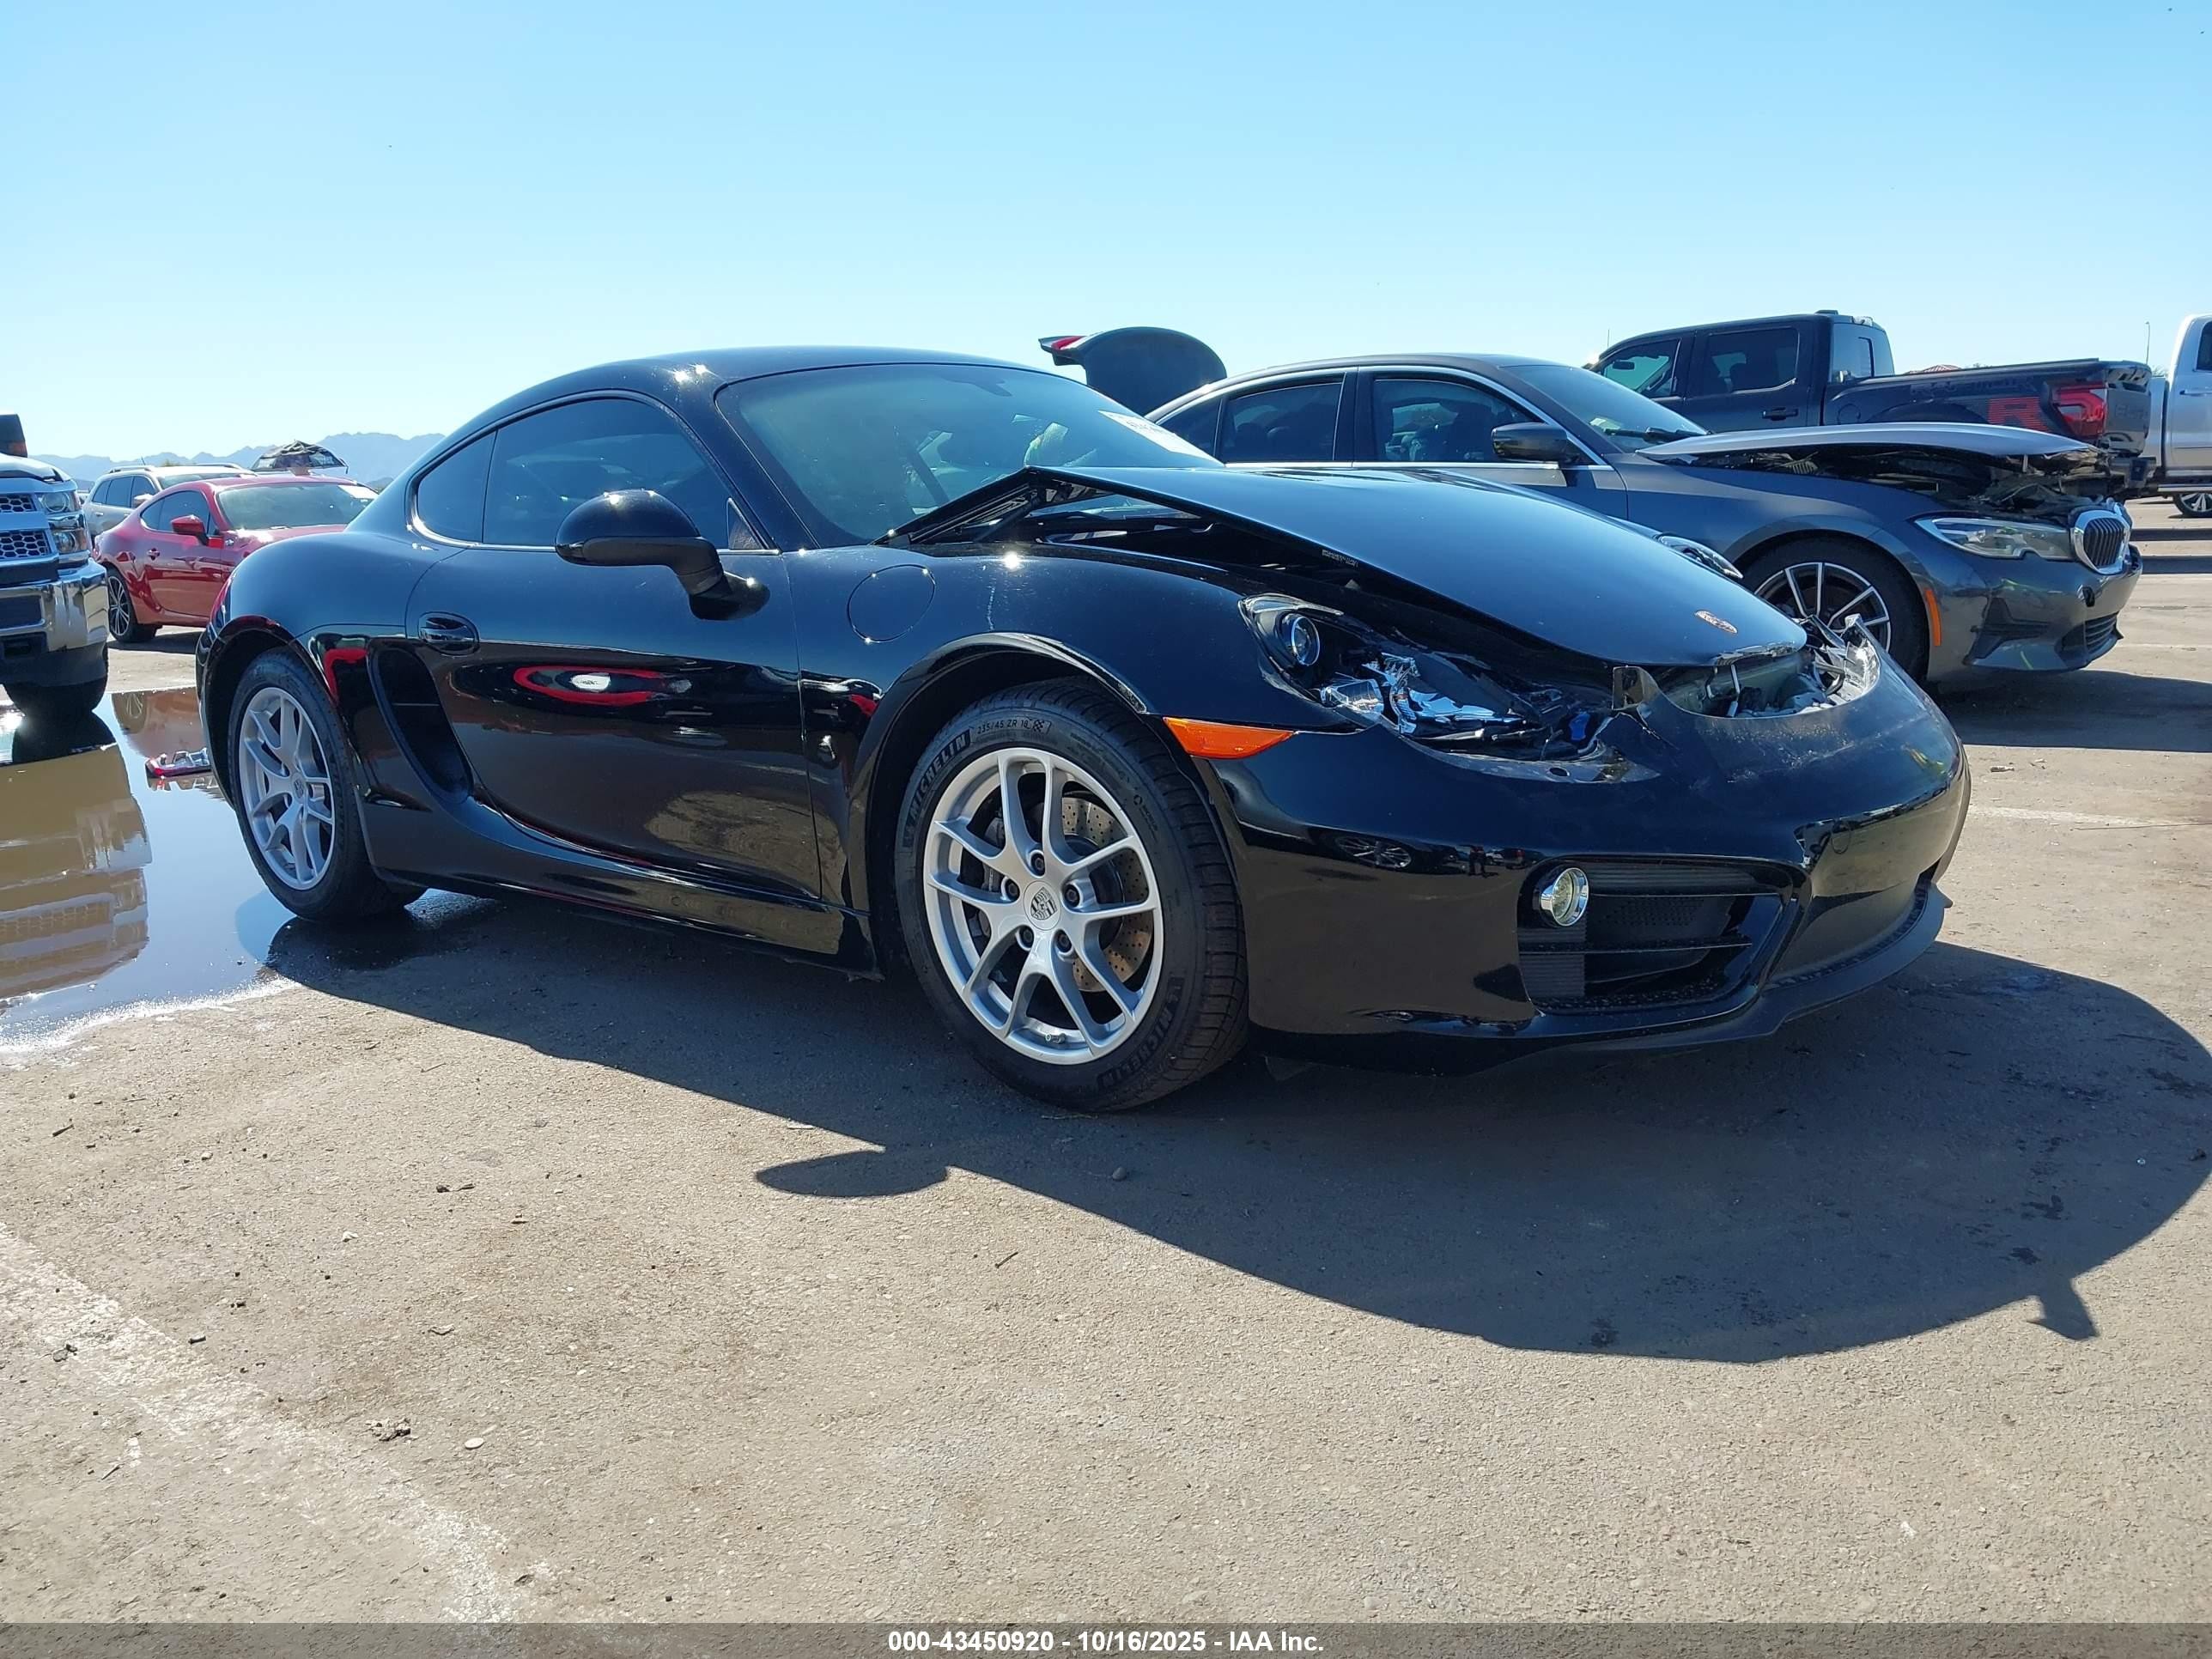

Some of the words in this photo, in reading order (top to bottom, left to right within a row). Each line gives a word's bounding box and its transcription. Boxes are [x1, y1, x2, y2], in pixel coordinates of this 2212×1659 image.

[977, 720, 1005, 735] 235/45
[1007, 719, 1018, 728] ZR
[909, 733, 968, 819] MICHELIN
